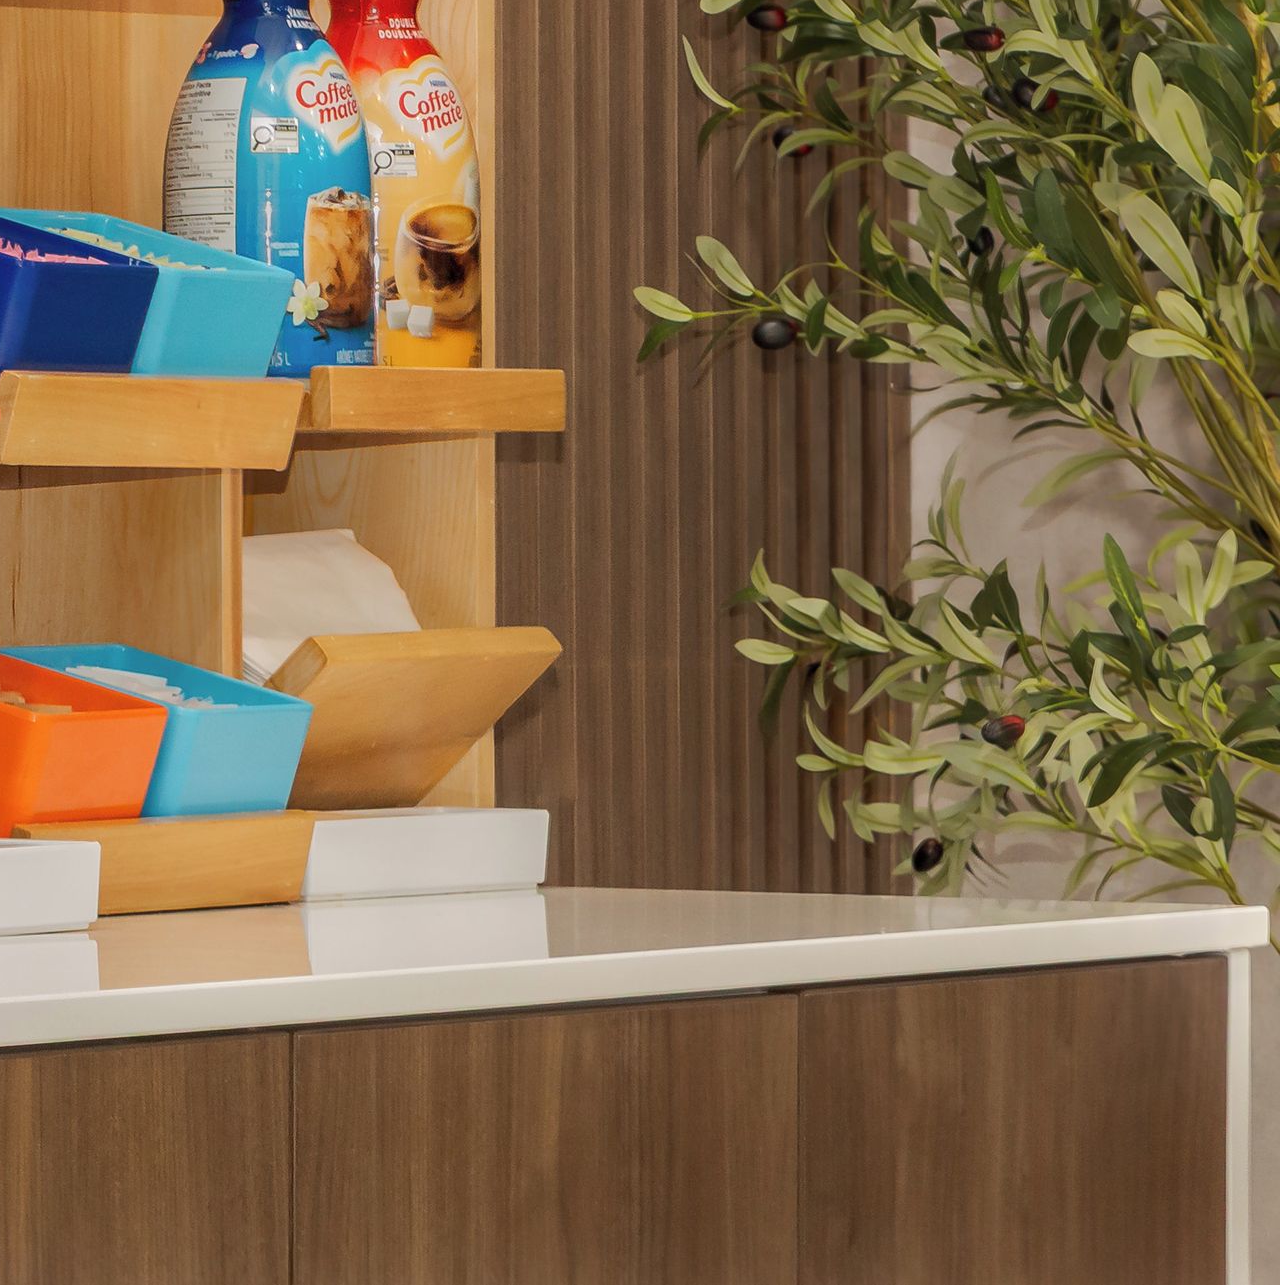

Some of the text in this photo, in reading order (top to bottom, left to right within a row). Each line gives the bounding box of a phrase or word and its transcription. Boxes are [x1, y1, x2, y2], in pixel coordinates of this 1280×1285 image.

[388, 17, 416, 30] DOUBLE
[295, 79, 353, 109] Coffee
[398, 89, 457, 119] Coffee
[319, 98, 358, 124] mate
[421, 105, 463, 134] mate
